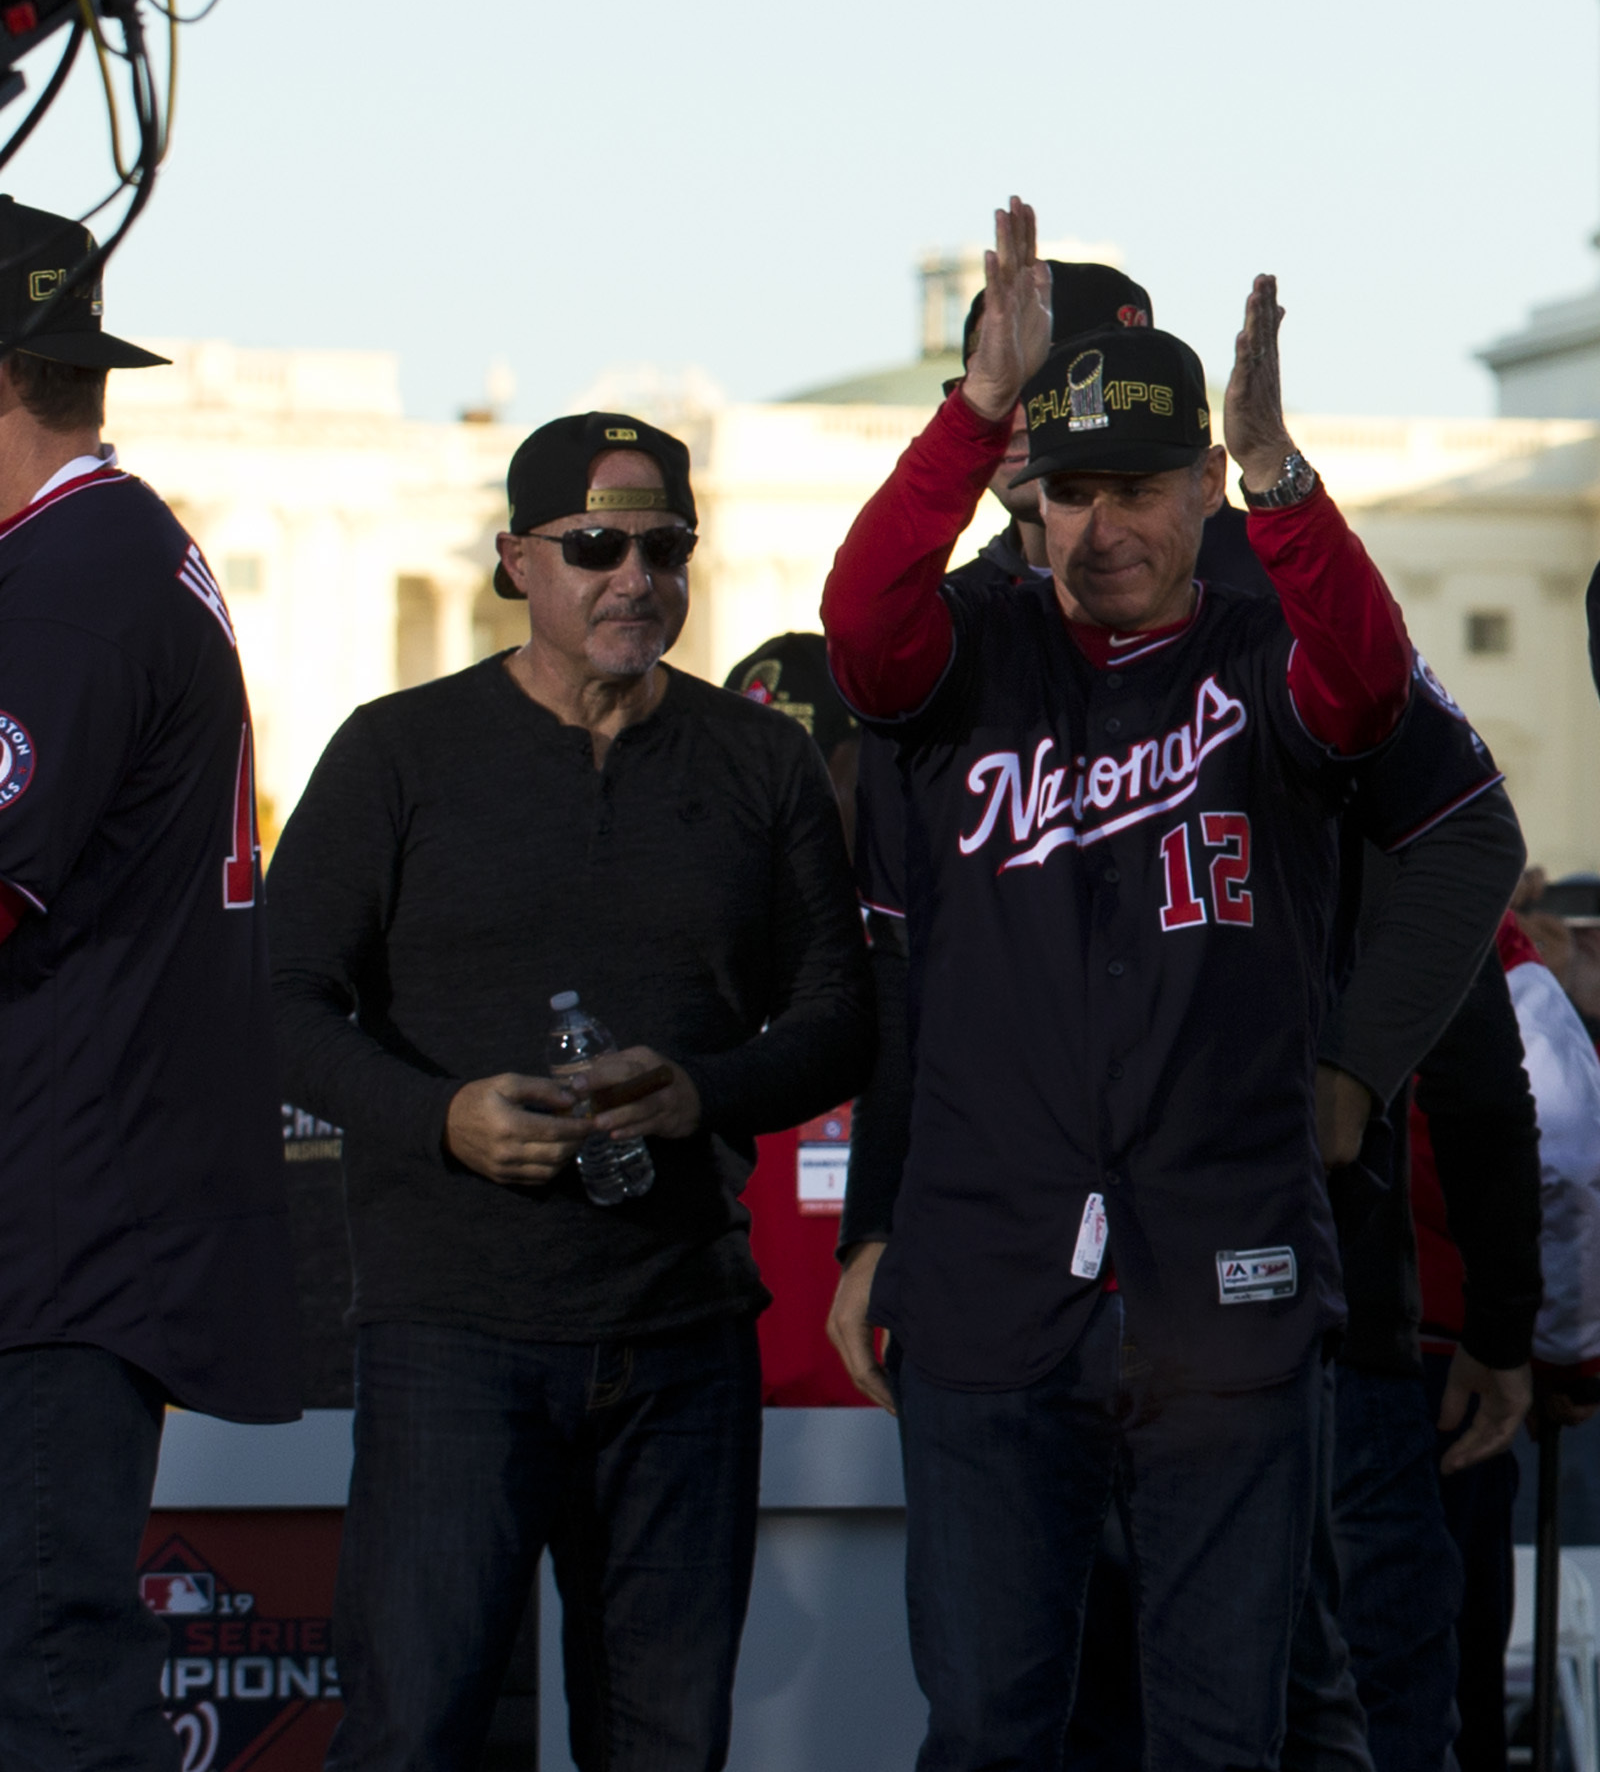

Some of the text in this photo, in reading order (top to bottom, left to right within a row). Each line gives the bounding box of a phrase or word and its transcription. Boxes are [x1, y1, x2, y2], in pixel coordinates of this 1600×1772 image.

[1158, 809, 1254, 932] 12
[217, 1593, 255, 1615] 19
[183, 1620, 328, 1653] SERIE
